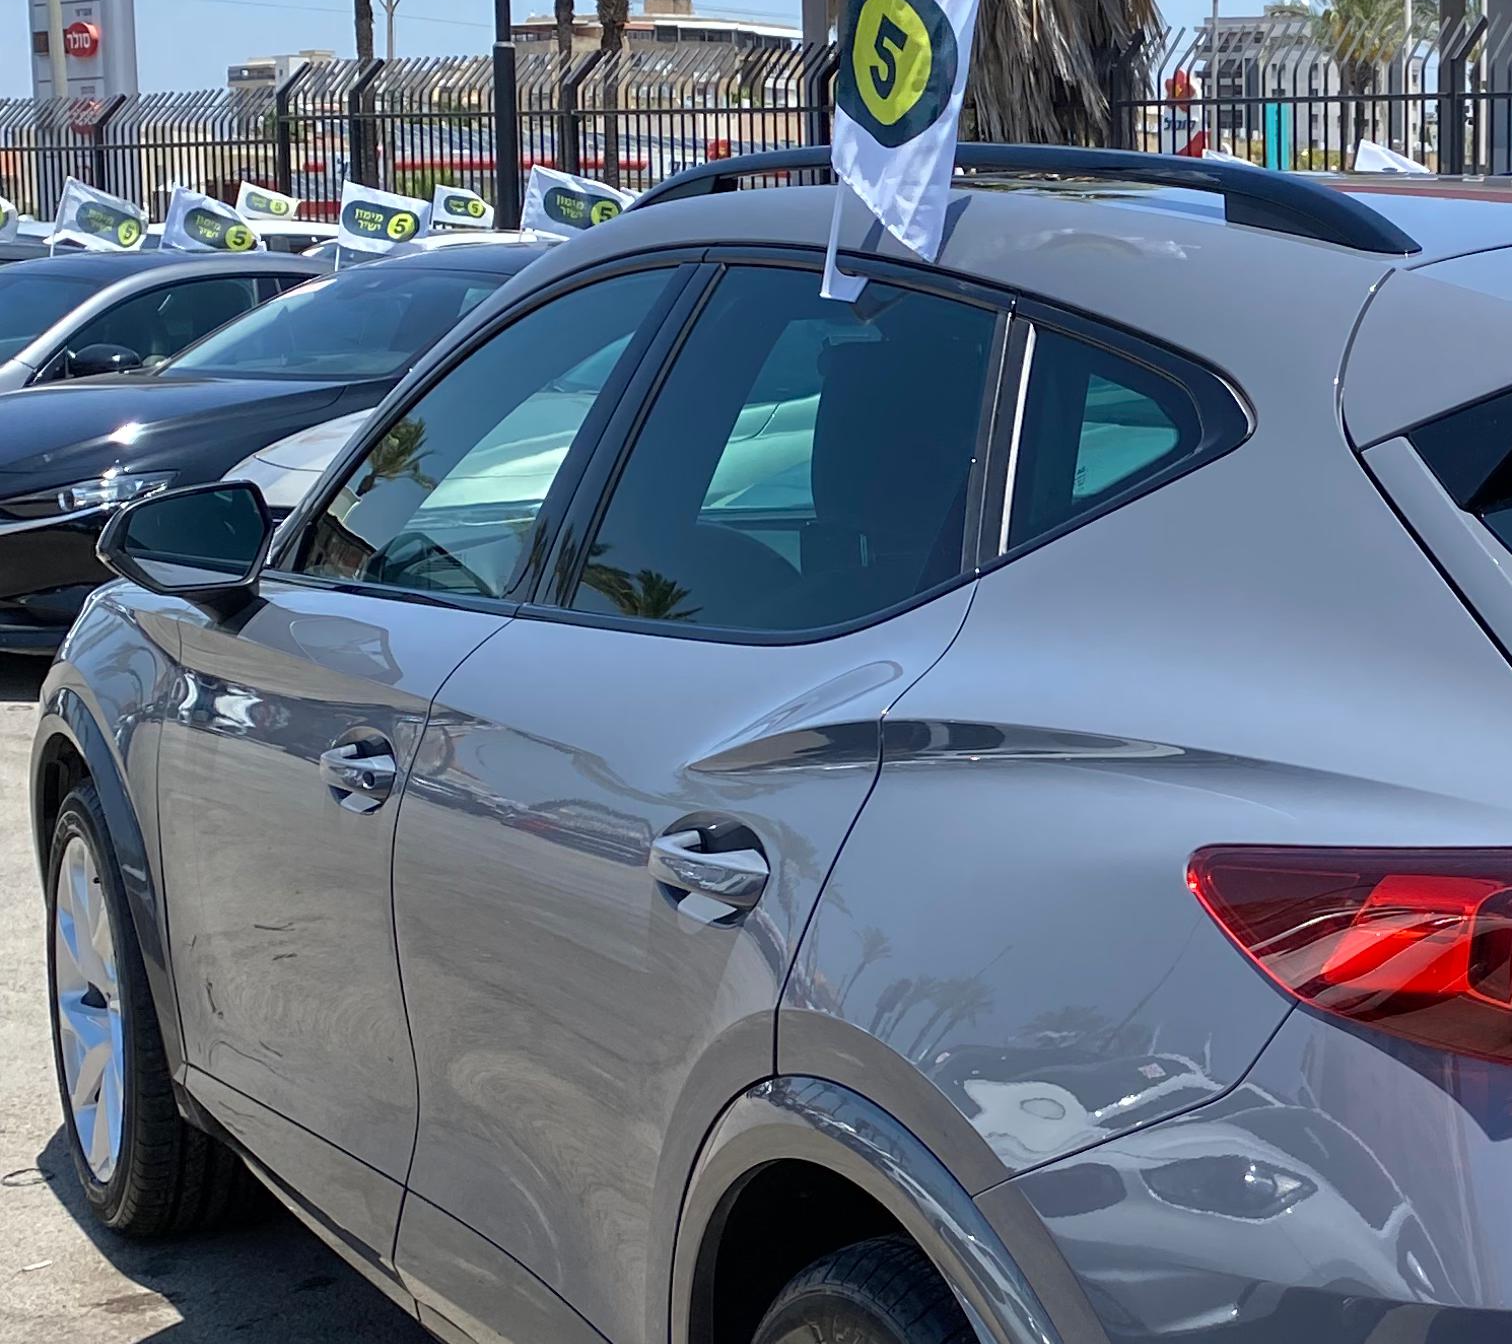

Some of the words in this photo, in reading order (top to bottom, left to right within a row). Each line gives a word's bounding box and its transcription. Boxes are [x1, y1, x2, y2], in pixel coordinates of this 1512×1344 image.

[66, 31, 91, 49] סולר
[869, 14, 908, 100] 5
[354, 208, 384, 222] מימון
[599, 206, 613, 223] 5
[357, 219, 381, 232] ישיר
[393, 218, 408, 235] 5
[232, 231, 247, 246] 5
